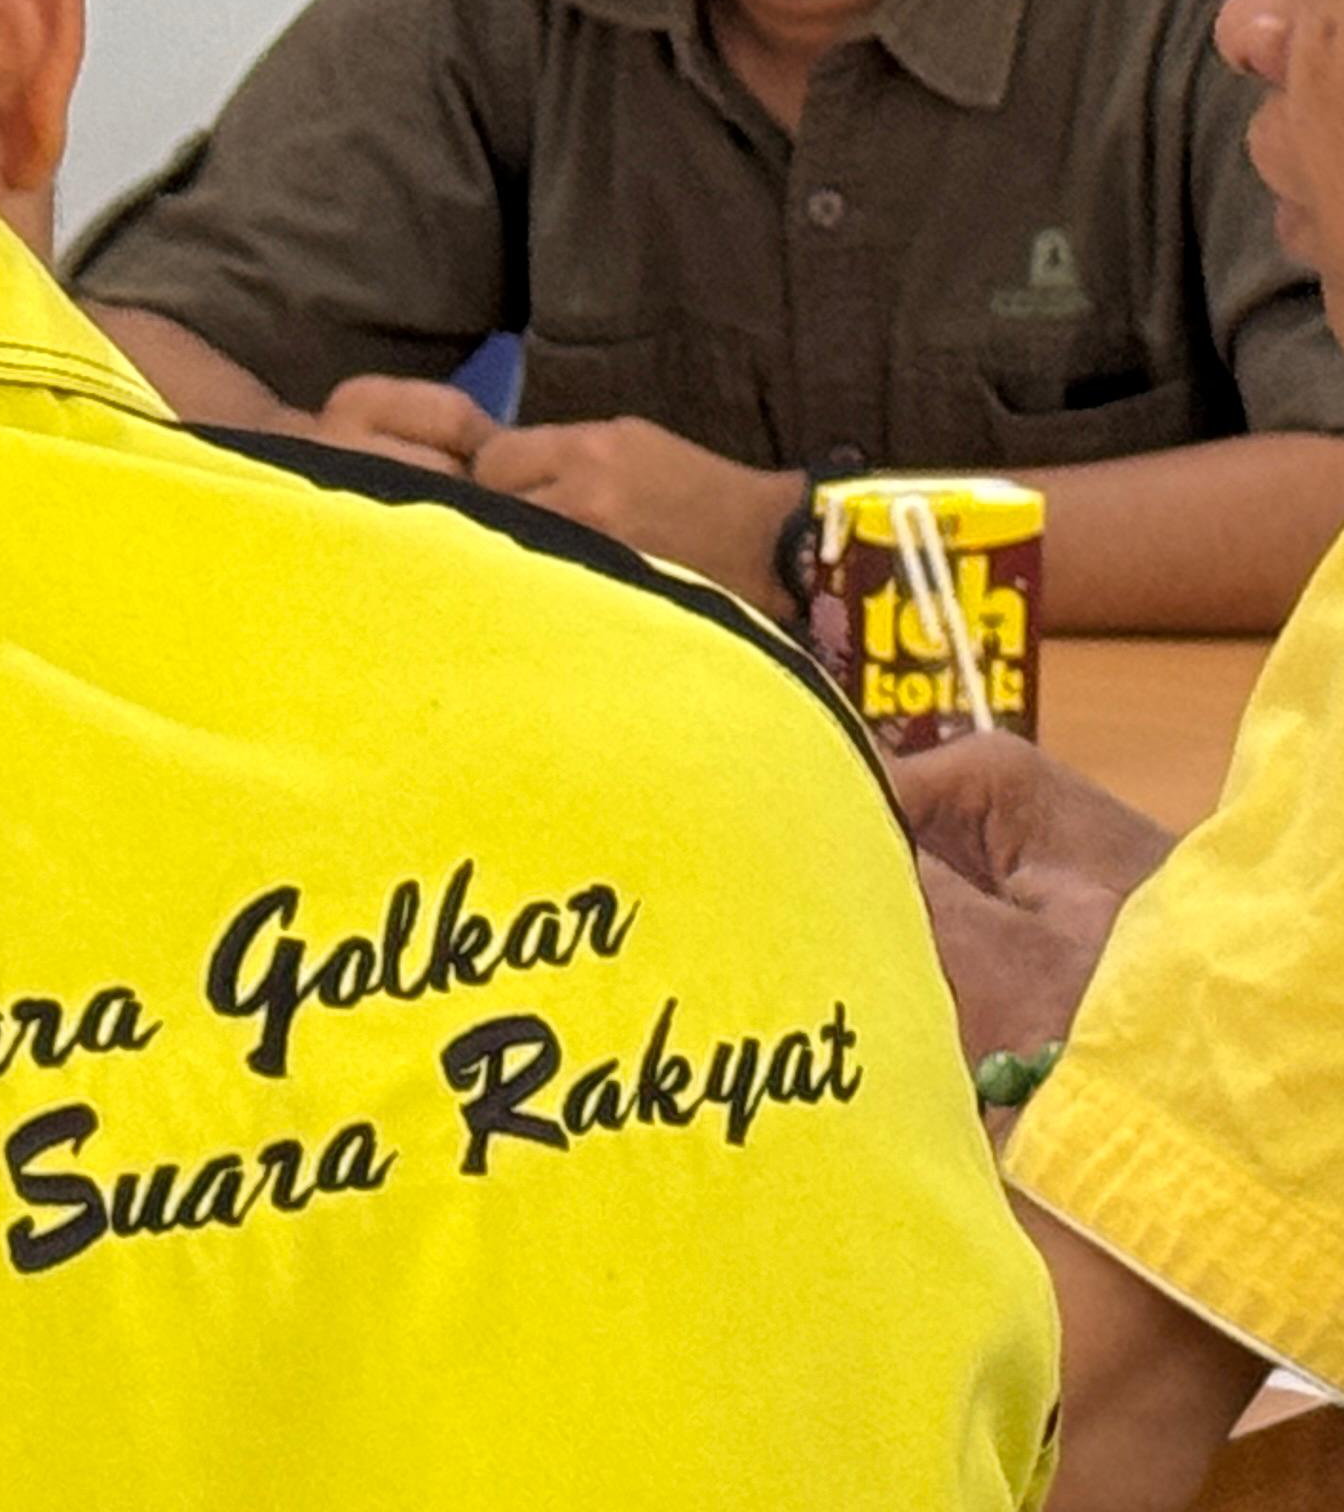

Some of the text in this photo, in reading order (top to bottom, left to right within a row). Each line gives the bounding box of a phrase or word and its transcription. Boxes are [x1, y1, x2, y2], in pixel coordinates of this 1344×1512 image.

[205, 859, 639, 1079] Golkar
[3, 999, 862, 1275] Suara Rakyat
